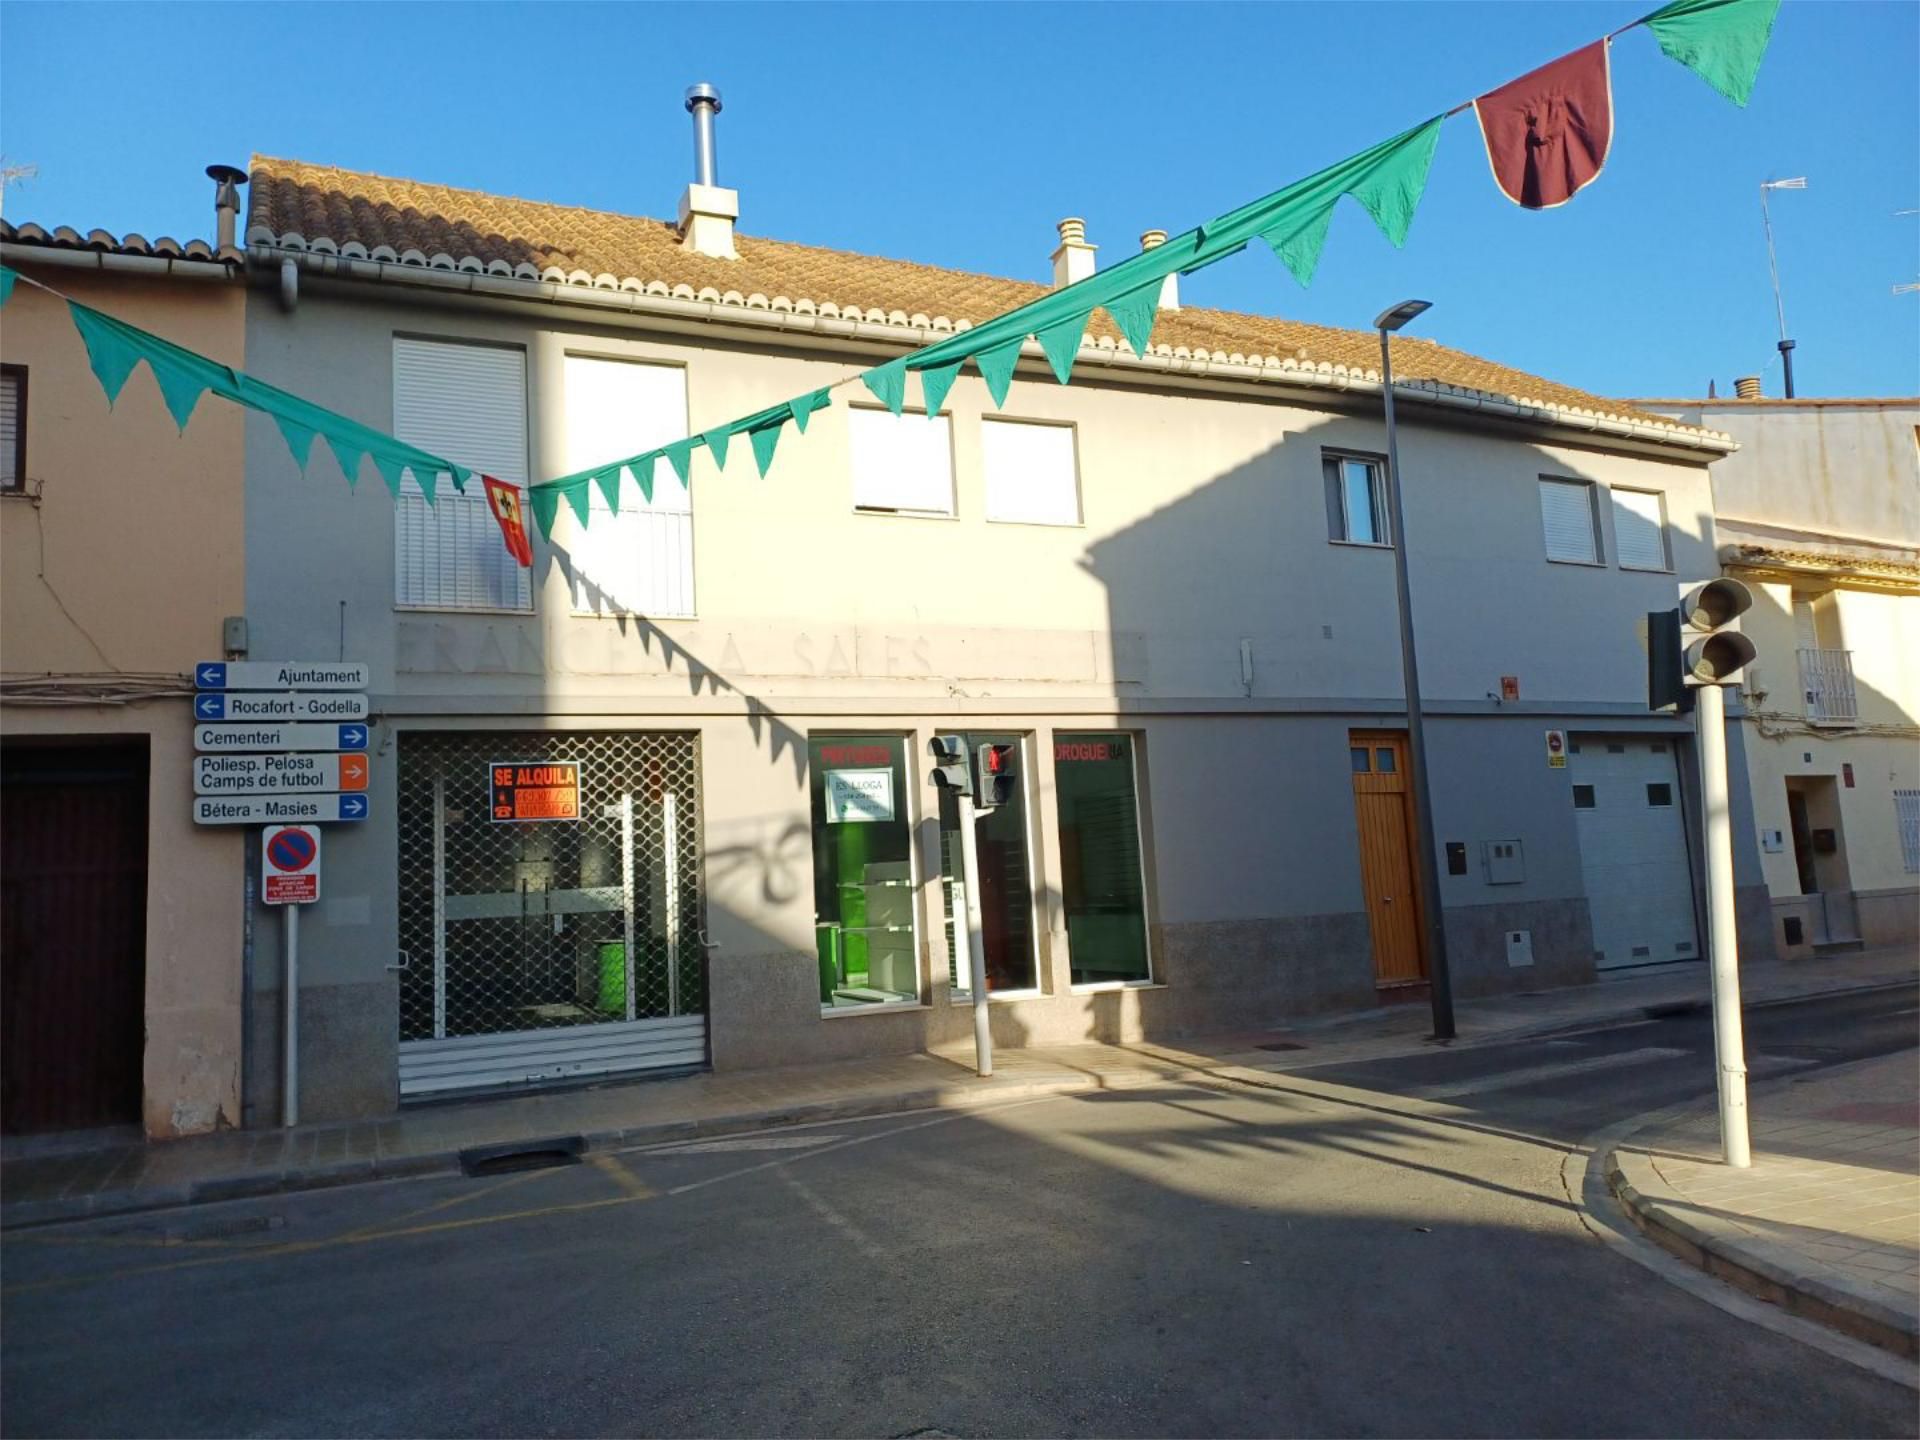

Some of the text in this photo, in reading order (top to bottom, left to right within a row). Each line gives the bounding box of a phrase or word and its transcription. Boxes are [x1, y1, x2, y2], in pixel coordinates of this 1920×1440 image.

[277, 669, 361, 685] Ajuntament
[232, 700, 295, 714] Rocafort
[308, 700, 361, 713] Godella
[202, 730, 281, 745] Cementeri
[201, 755, 314, 774] Poliesp. Pelosa
[201, 772, 324, 790] Camps de futbol
[495, 767, 575, 786] SE ALQUILA
[201, 803, 250, 818] Bétera
[265, 801, 318, 816] Masies
